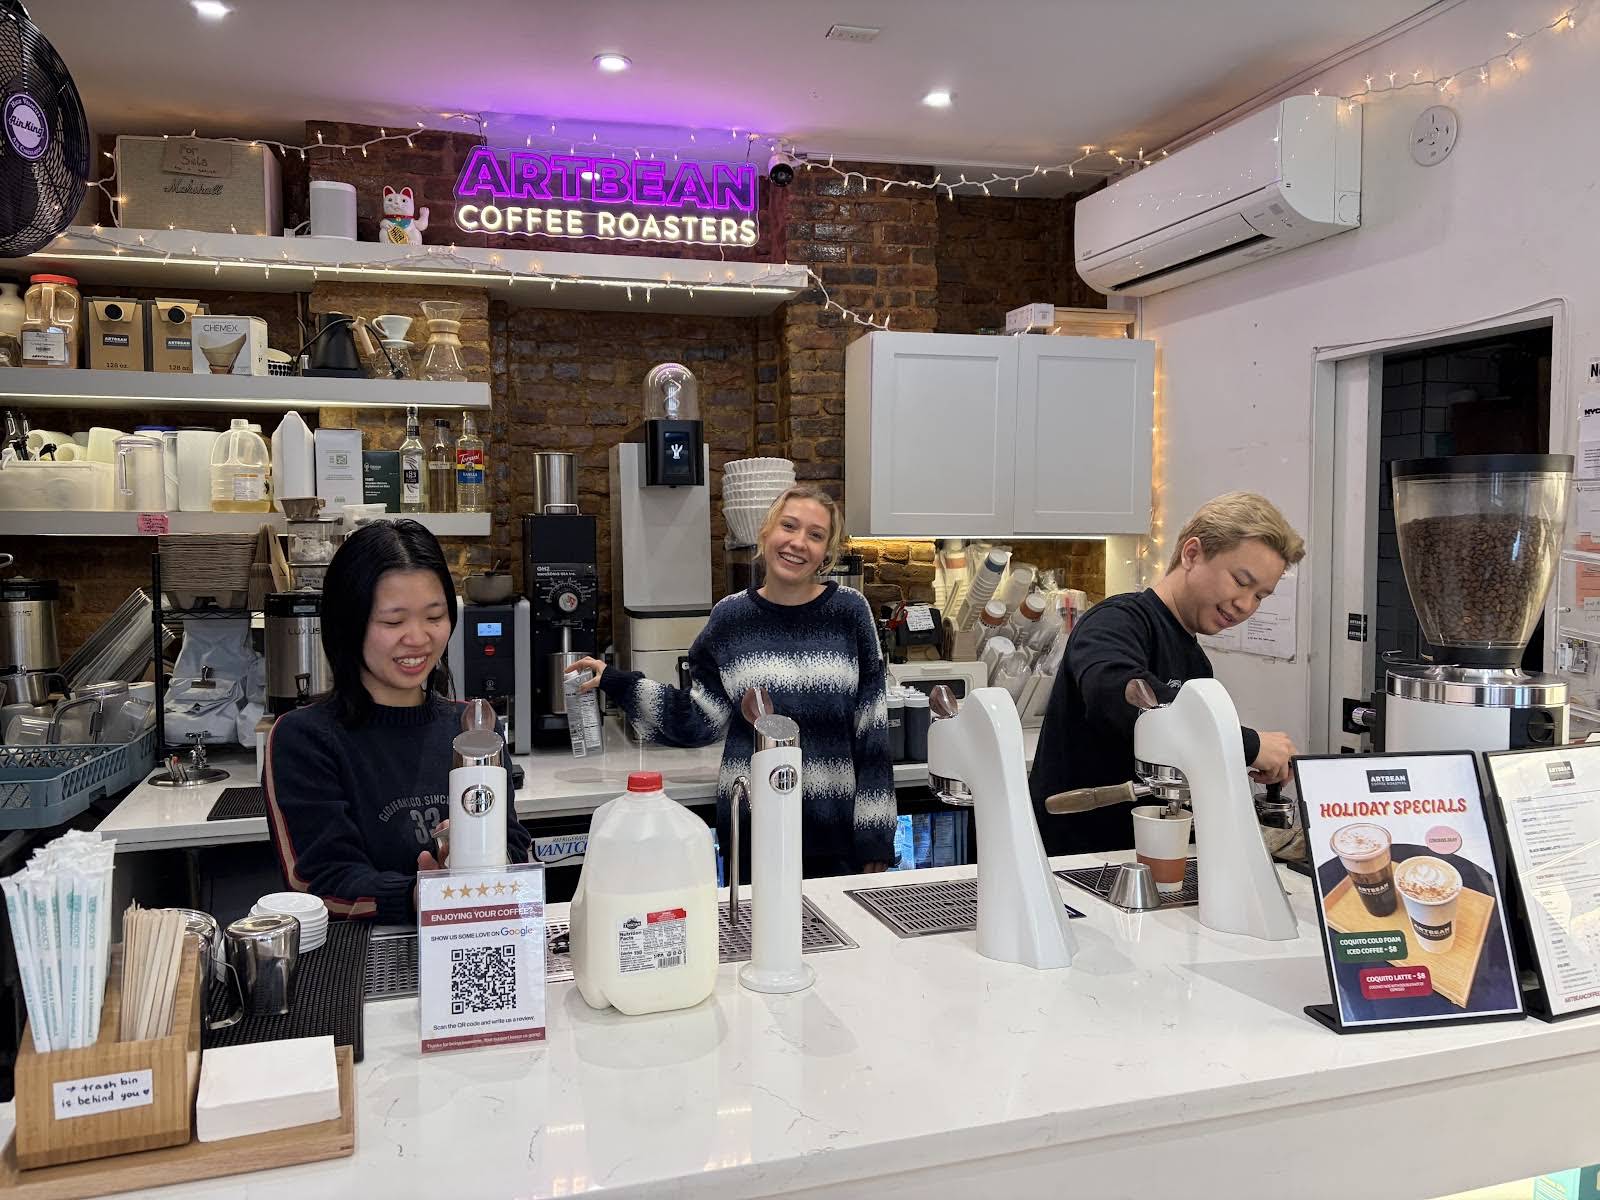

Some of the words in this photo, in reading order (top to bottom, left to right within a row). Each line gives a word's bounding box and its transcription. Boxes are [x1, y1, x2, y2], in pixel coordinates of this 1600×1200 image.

[457, 149, 758, 211] ARTBEAN
[458, 204, 584, 235] COFFEE
[597, 211, 757, 244] ROASTERS
[203, 324, 239, 333] CHEMEX
[1590, 363, 1600, 378] N
[1370, 775, 1406, 783] ARTBEAN
[1320, 800, 1390, 818] HOLIDAY
[1393, 798, 1468, 815] SPECIALS
[431, 911, 472, 922] ENJOYING
[473, 909, 497, 919] YOUR
[497, 906, 533, 917] COFFEE?
[500, 925, 533, 937] Google
[1339, 938, 1367, 946] COQUITO
[1366, 975, 1393, 983] COQUITO
[1393, 973, 1412, 981] LATTE
[80, 1081, 117, 1092] trash
[120, 1077, 138, 1085] bin
[61, 1100, 72, 1108] is
[77, 1091, 114, 1106] behind
[120, 1091, 140, 1101] you
